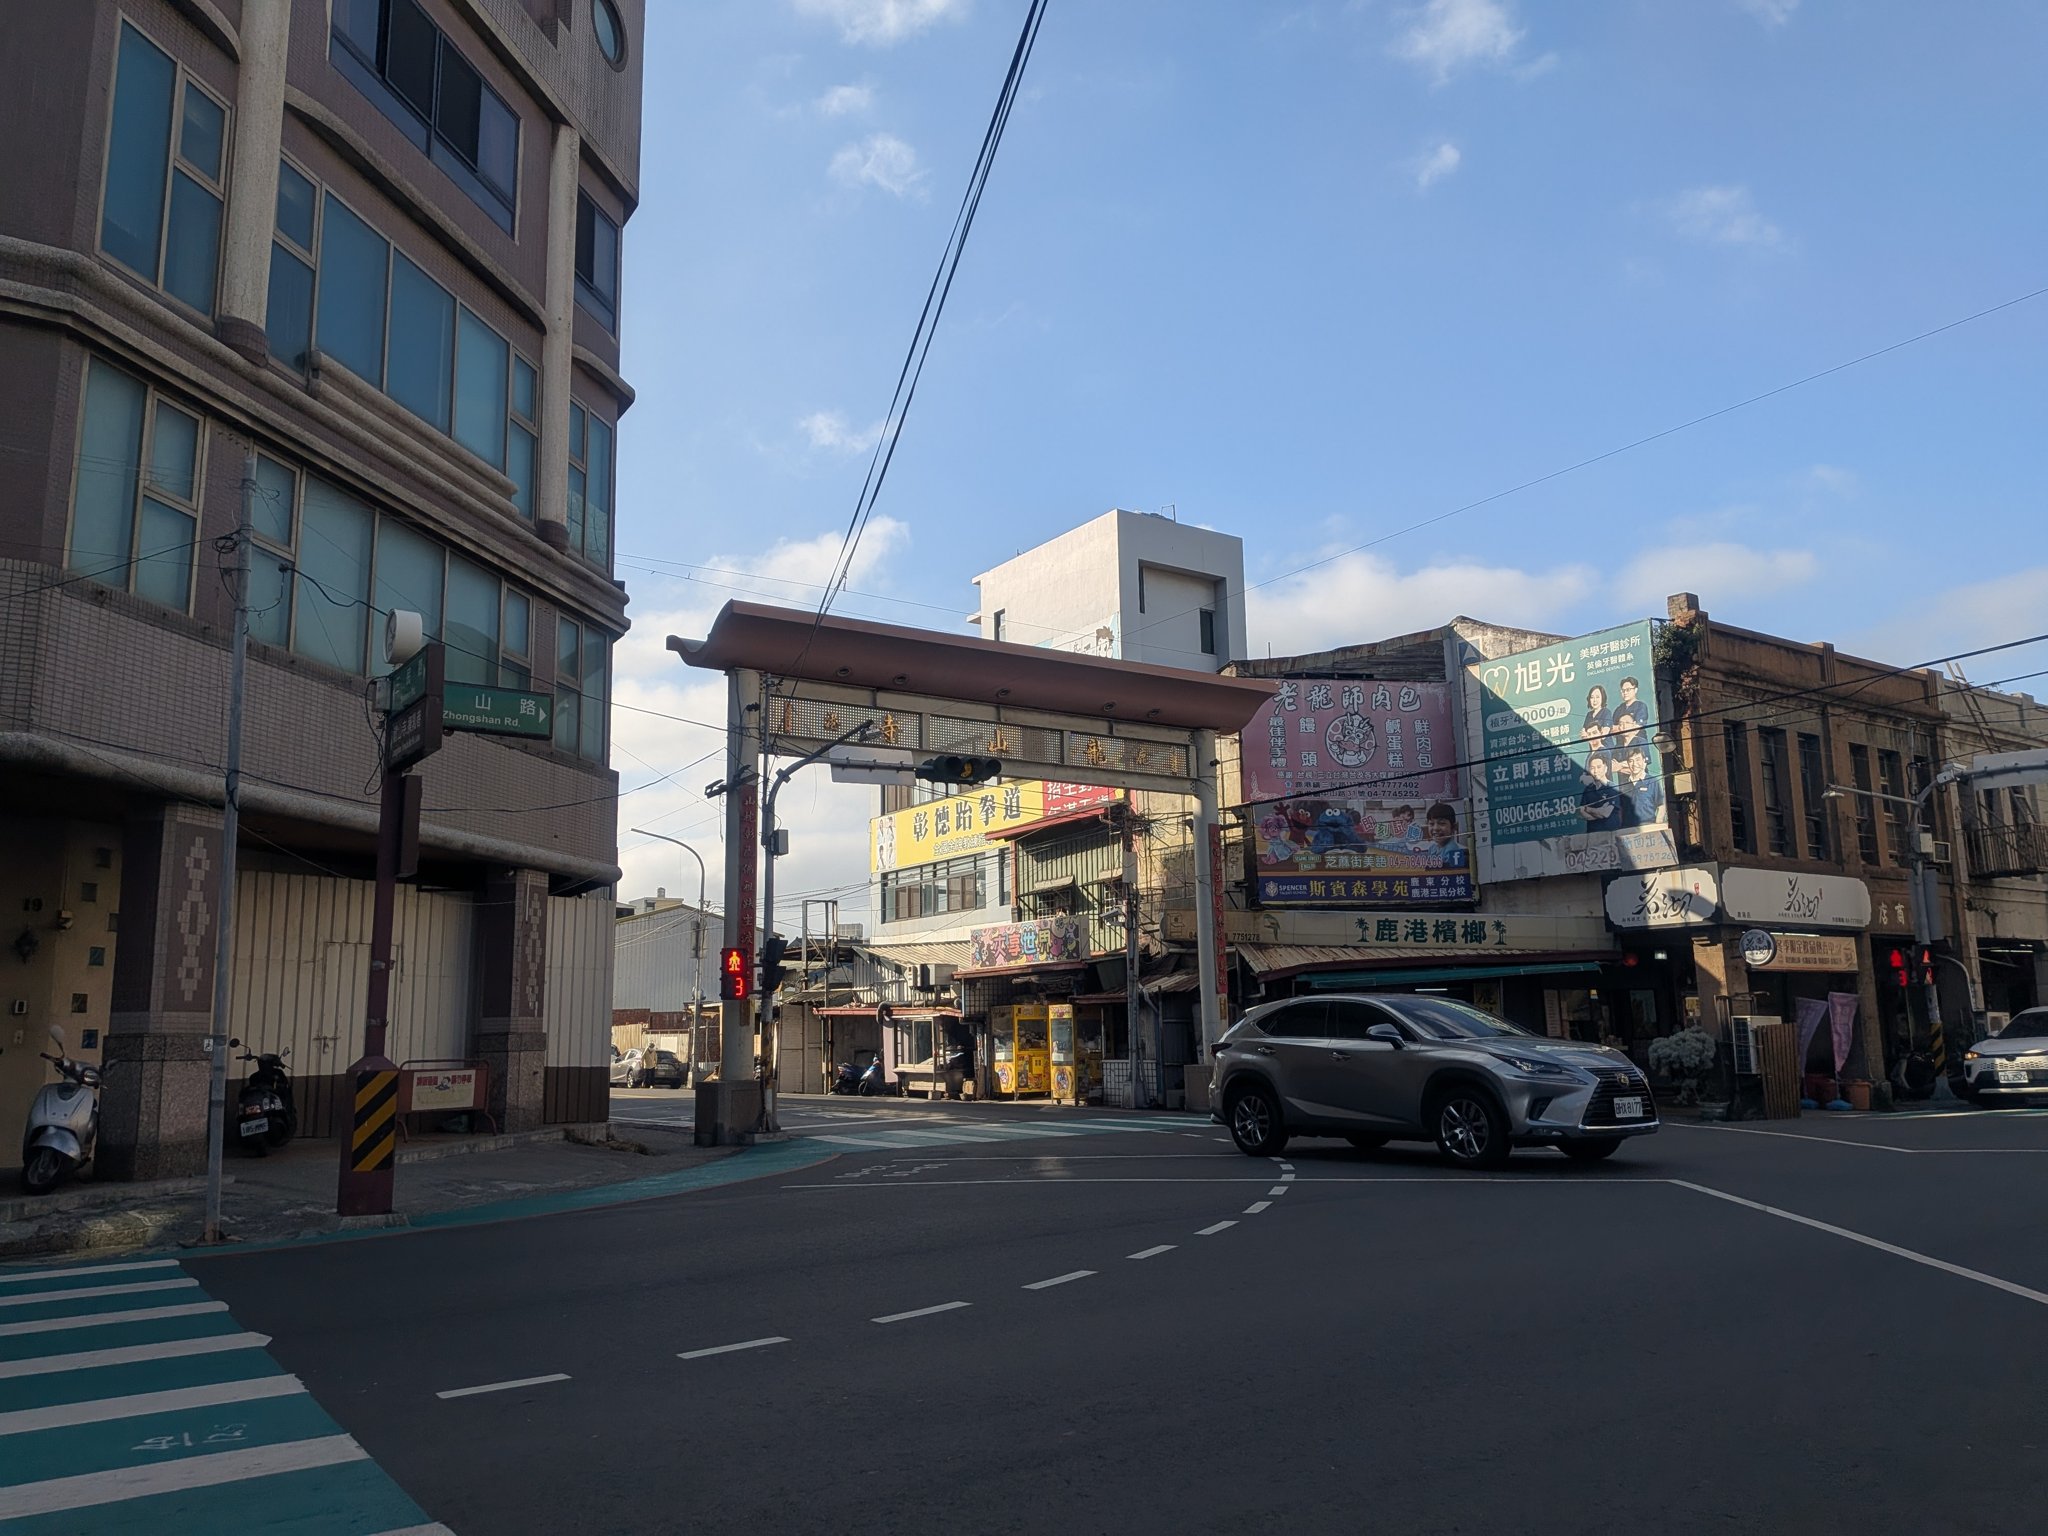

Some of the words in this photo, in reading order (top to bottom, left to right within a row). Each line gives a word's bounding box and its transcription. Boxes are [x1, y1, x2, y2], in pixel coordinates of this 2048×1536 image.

[1579, 634, 1641, 660] 美學牙醫診所
[1514, 652, 1575, 695] 旭光
[1273, 680, 1421, 715] 老龍師肉包
[504, 716, 521, 728] Rd.
[1413, 719, 1433, 768] 鮮肉包
[1492, 755, 1572, 783] 立即預約
[911, 785, 1022, 843] 彰德跆拳道
[1495, 796, 1576, 825] 0800-666-368
[1309, 879, 1409, 897] 斯賓森學苑
[1410, 875, 1465, 886] 鹿東分校
[1411, 886, 1466, 898] 鹿港三民分校
[1375, 917, 1487, 945] 鹿港檳榔
[735, 977, 743, 996] 3
